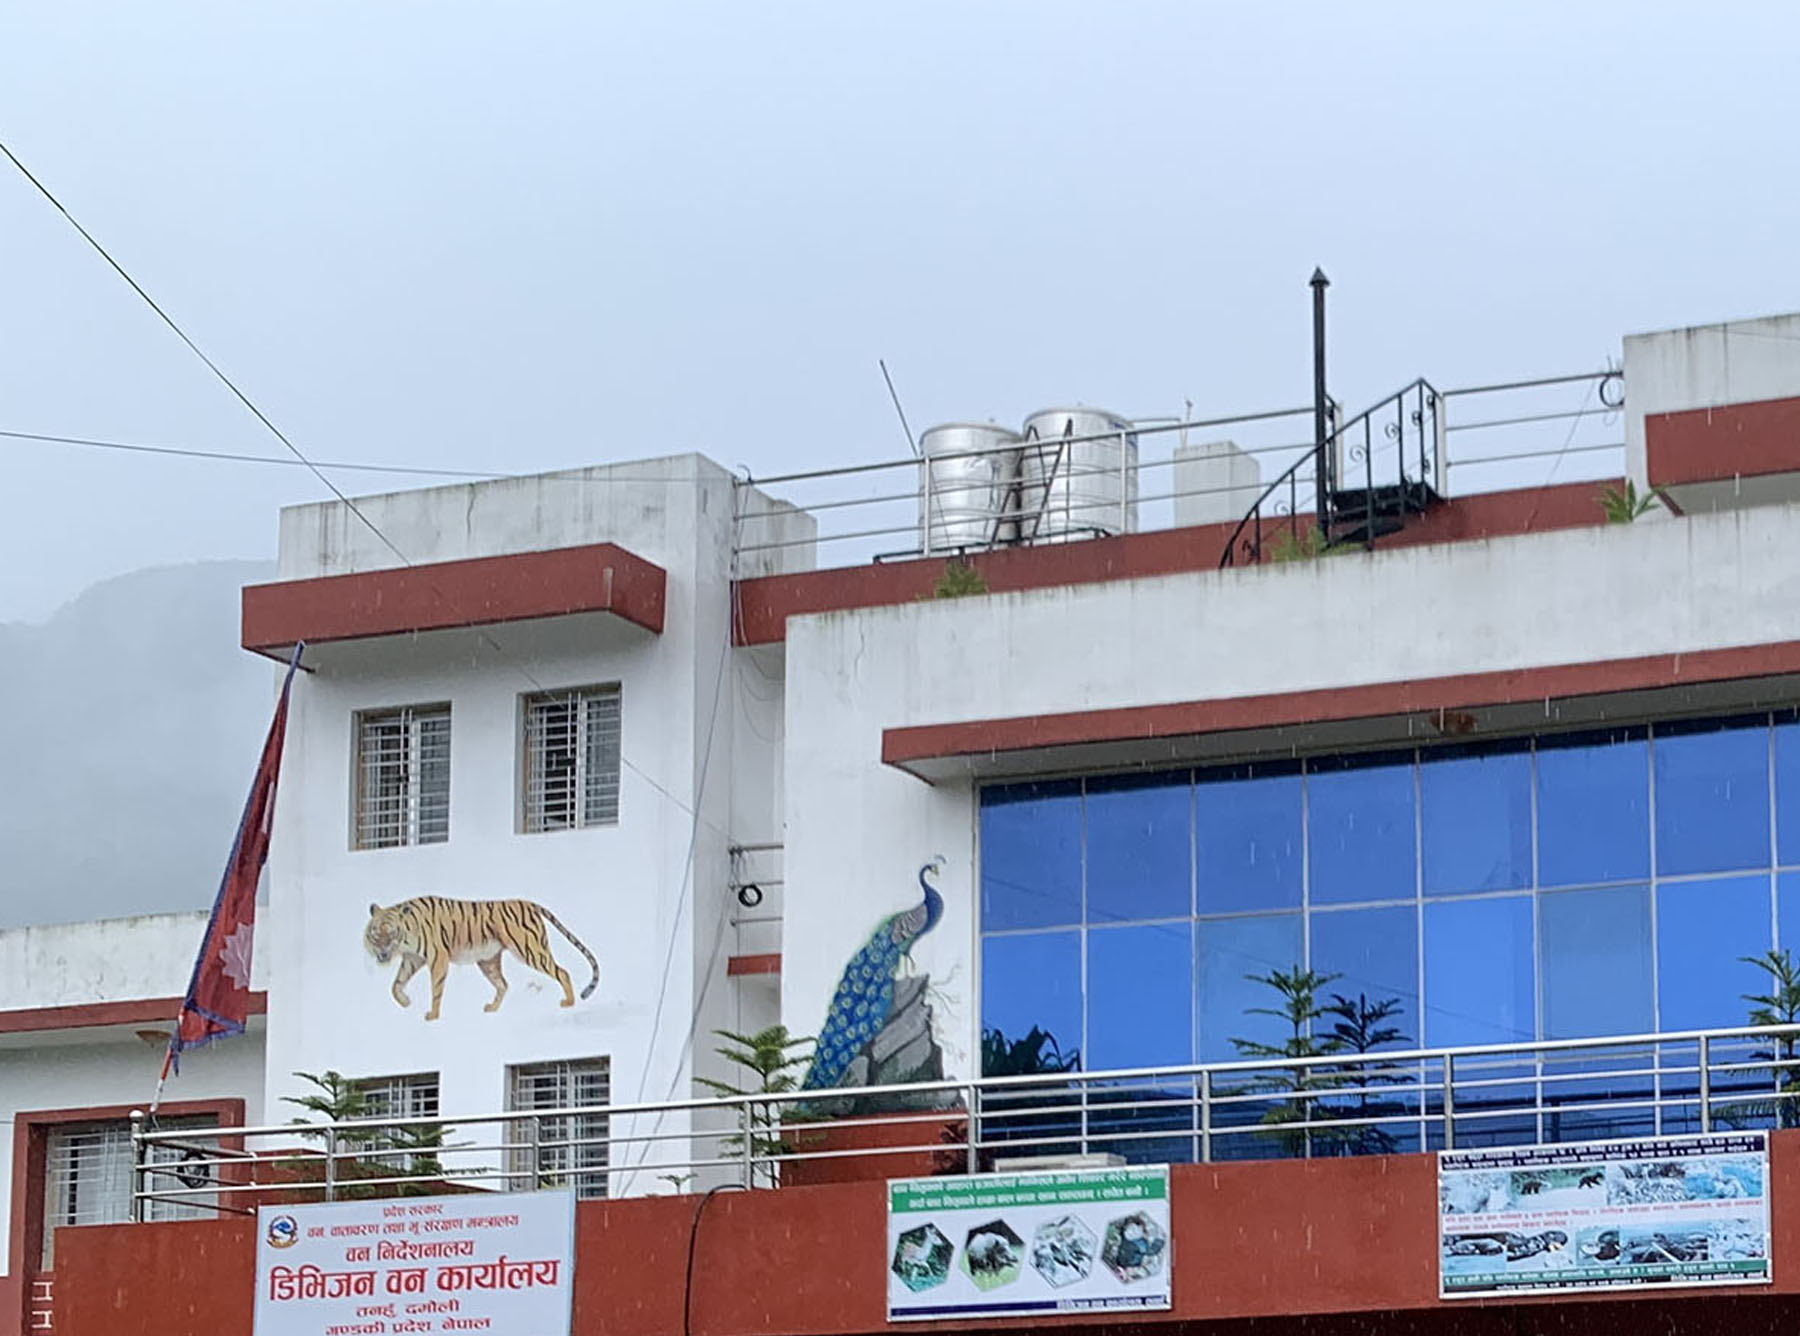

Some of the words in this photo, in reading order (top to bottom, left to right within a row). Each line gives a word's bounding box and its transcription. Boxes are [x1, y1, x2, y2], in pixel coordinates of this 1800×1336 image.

[346, 1246, 370, 1263] वन
[377, 1240, 474, 1261] निर्देशनालय
[270, 1265, 376, 1300] डिभिजन
[386, 1268, 428, 1295] वन
[437, 1256, 560, 1291] कार्यालय
[327, 1320, 386, 1336] गण्डकी
[392, 1320, 432, 1334] प्रदेश
[441, 1316, 492, 1331] नेपाल
